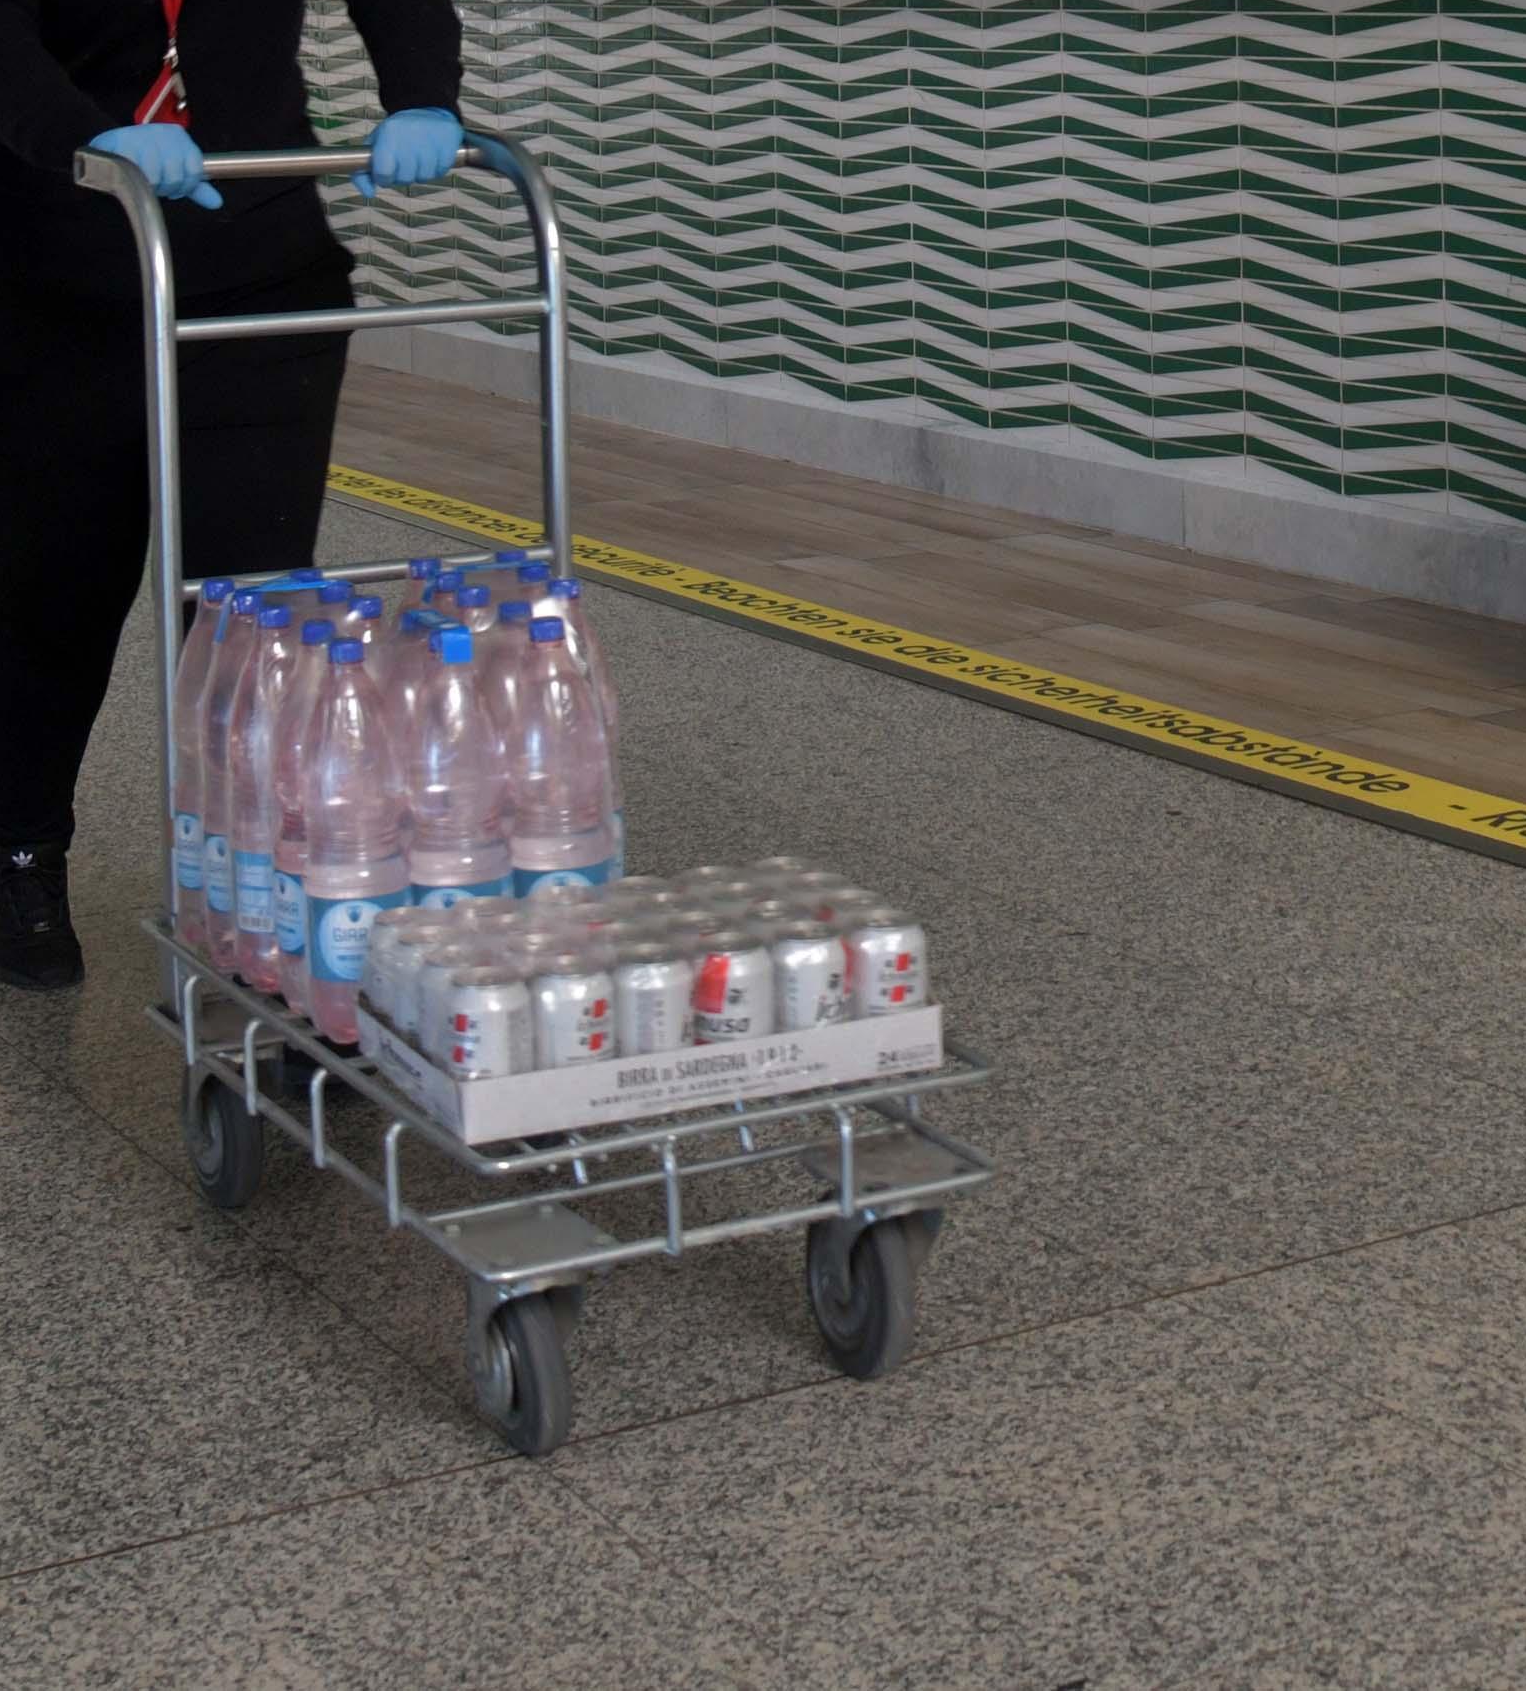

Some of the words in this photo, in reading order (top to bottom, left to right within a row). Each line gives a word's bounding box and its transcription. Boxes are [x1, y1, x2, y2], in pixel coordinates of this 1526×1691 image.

[682, 580, 849, 632] Beachten
[836, 626, 903, 646] sie
[894, 641, 970, 666] die
[617, 1067, 657, 1089] BIRRA
[675, 1052, 748, 1080] SARDEGNA
